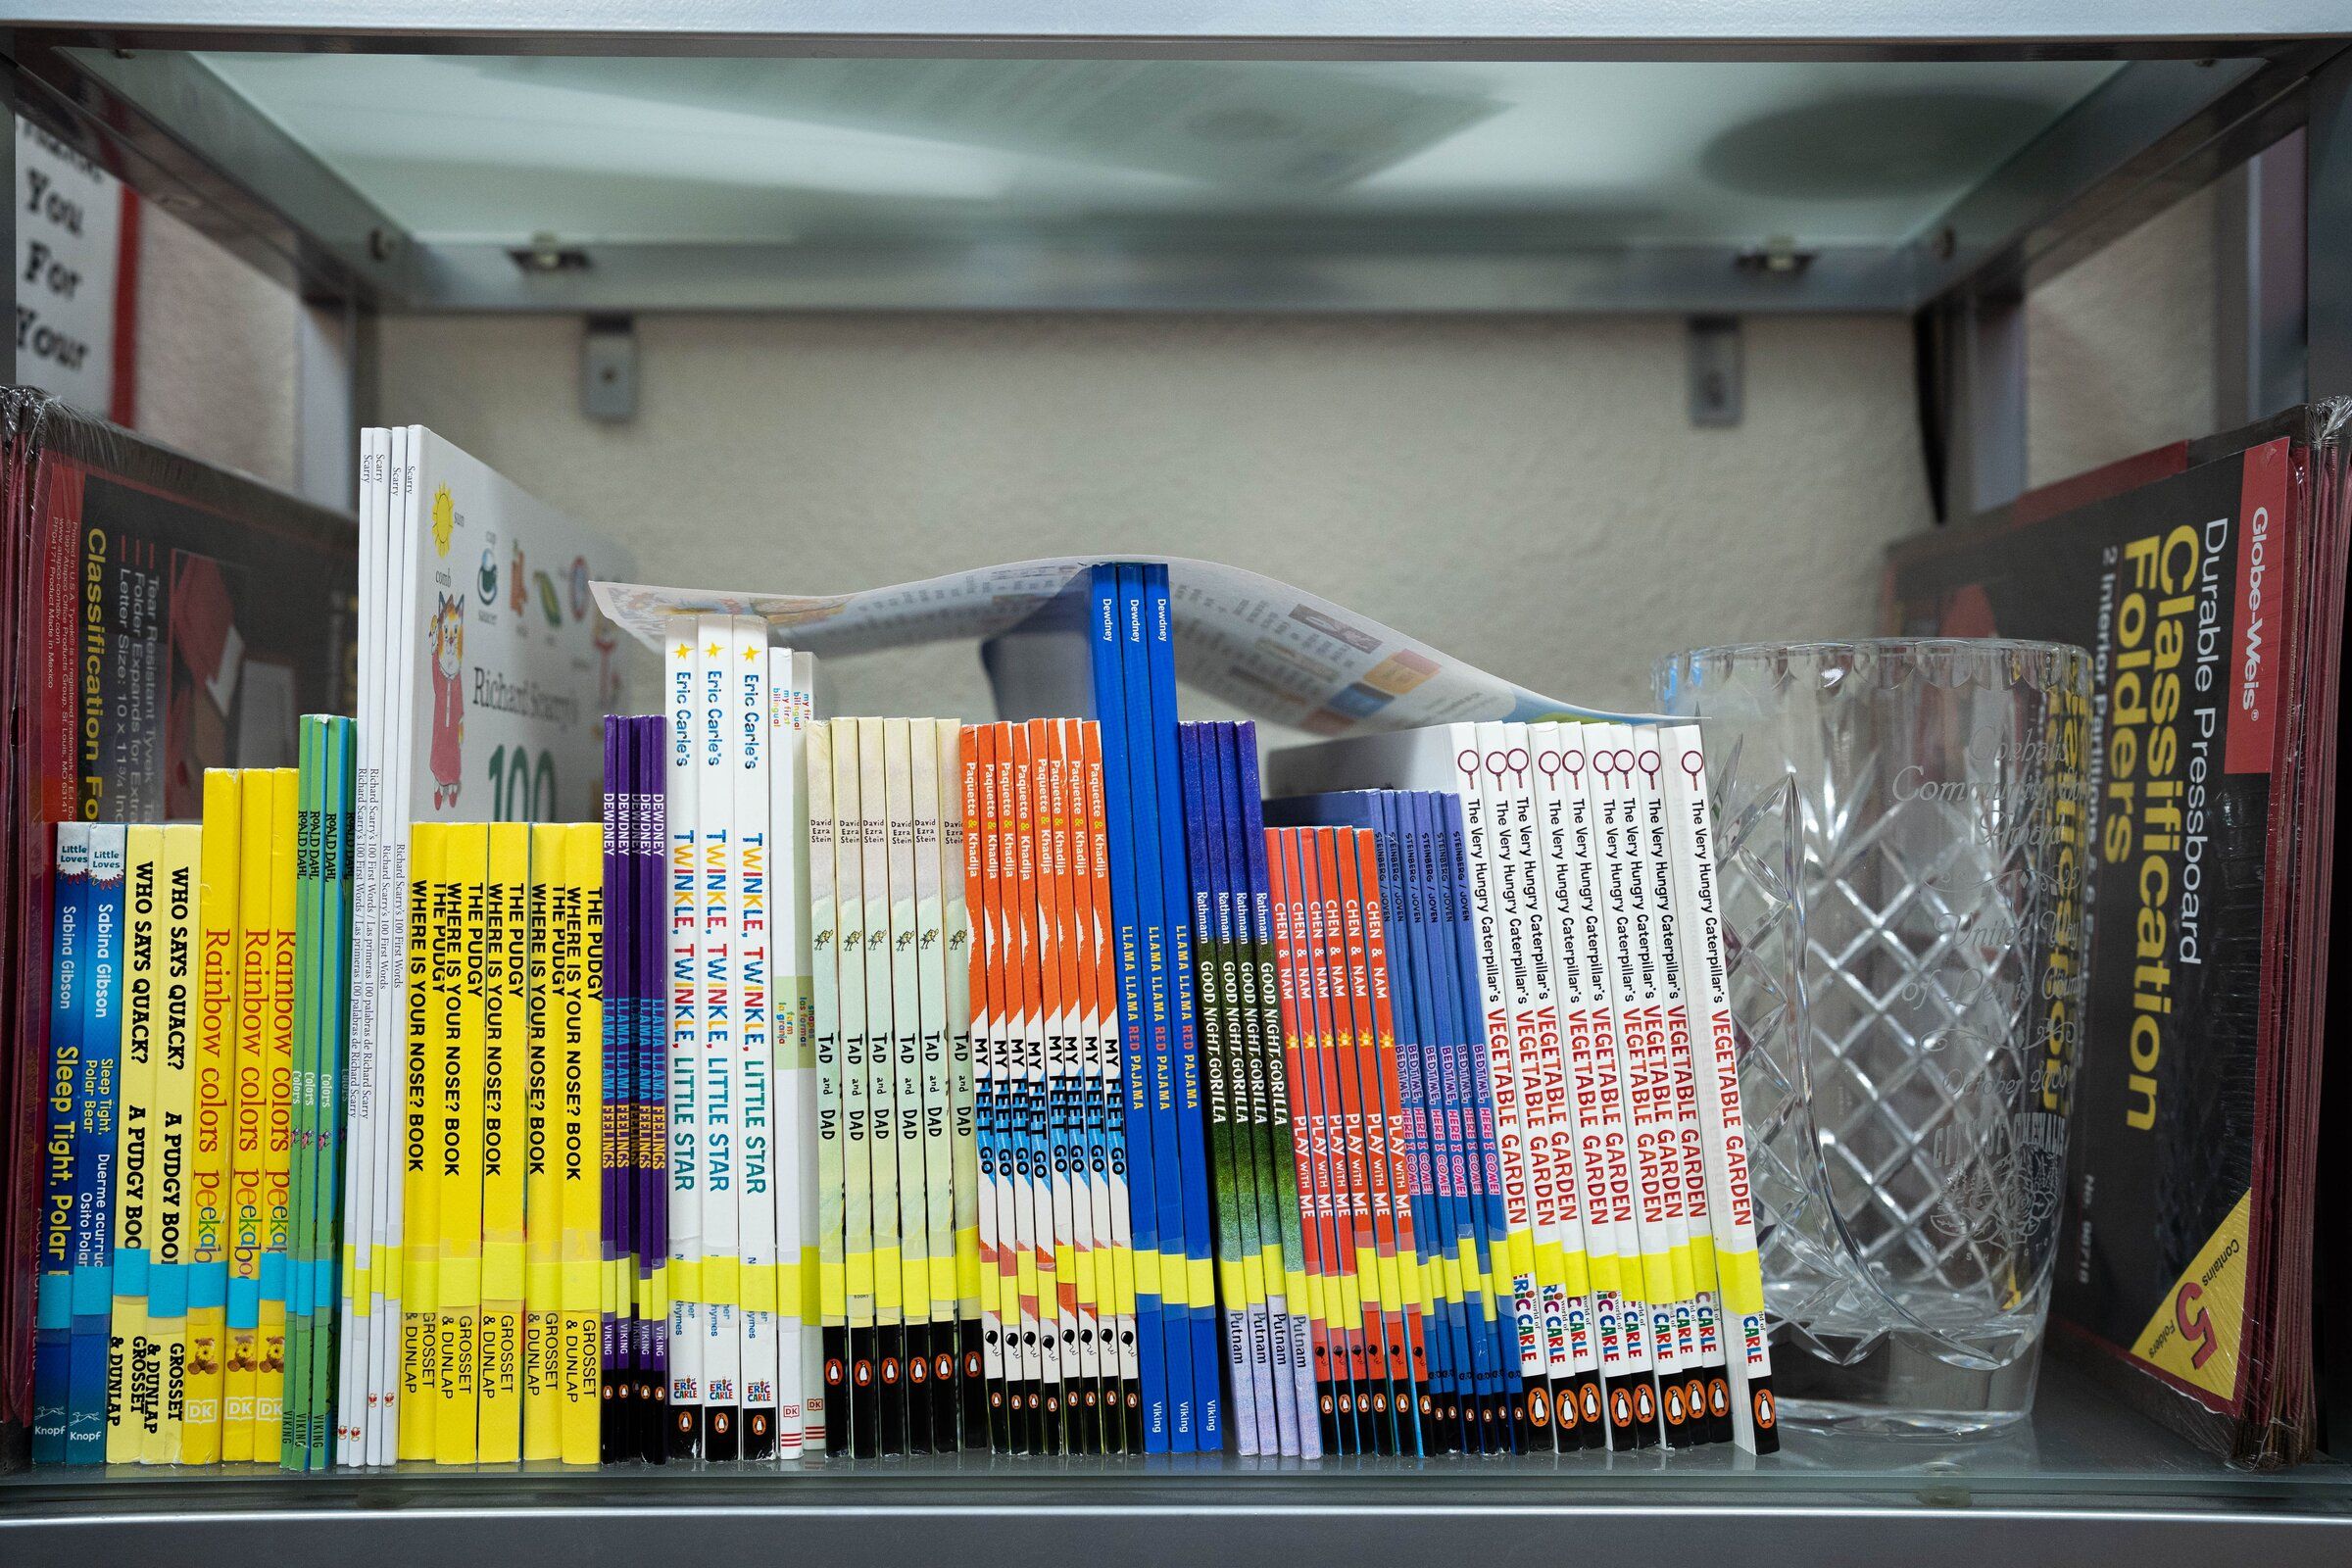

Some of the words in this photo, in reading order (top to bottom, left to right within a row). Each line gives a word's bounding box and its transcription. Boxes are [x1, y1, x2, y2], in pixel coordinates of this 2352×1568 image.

[374, 454, 384, 483] Scarry
[454, 512, 465, 527] sun
[2103, 545, 2119, 564] 2
[119, 568, 131, 629] Letter
[146, 576, 160, 620] Tear
[435, 568, 452, 588] comb
[131, 571, 145, 637] Folder
[1157, 598, 1167, 642] Dewdney
[2195, 517, 2228, 692] Durable
[86, 528, 106, 761] Classification
[2093, 573, 2118, 685] Interior
[117, 635, 129, 685] Size:
[145, 625, 158, 725] Resistant
[117, 694, 127, 717] 10
[130, 641, 143, 732] Expands
[744, 674, 759, 707] Eric
[771, 687, 780, 727] bilingual
[784, 690, 791, 705] my
[2106, 535, 2160, 863] Folders
[130, 738, 141, 766] for
[744, 710, 760, 769] Carle's
[369, 768, 379, 803] Richard
[1001, 762, 1011, 816] Paquette
[368, 805, 378, 840] Scarry's
[617, 794, 629, 857] DEWDNEY
[1004, 819, 1013, 829] &
[1468, 798, 1480, 824] The
[2127, 524, 2199, 1131] Classification
[94, 851, 120, 860] Little
[1004, 833, 1014, 878] Khadija
[1470, 827, 1484, 859] Very
[2180, 708, 2216, 964] Pressboard
[92, 860, 121, 870] Loves
[309, 848, 319, 880] DAHL
[368, 861, 376, 880] First
[741, 833, 762, 937] TWINKLE,
[1453, 831, 1465, 881] STEINBERG
[1460, 892, 1469, 921] JOVEN
[134, 861, 154, 914] WHO
[367, 883, 376, 912] Words
[467, 882, 484, 921] THE
[1474, 861, 1489, 913] Hungry
[98, 905, 113, 958] Sabina
[366, 921, 375, 937] Las
[446, 882, 462, 954] WHERE
[1236, 892, 1248, 945] Rathmann
[1325, 900, 1340, 937] CHEN
[134, 920, 152, 972] SAYS
[365, 938, 374, 978] primeras
[466, 927, 483, 999] PUDGY
[1149, 926, 1161, 972] LLAMA
[1330, 947, 1341, 956] &
[1481, 916, 1500, 1003] Caterpillar's
[95, 963, 112, 1018] Gibson
[446, 959, 461, 979] IS
[1332, 965, 1346, 997] NAM
[203, 929, 230, 1058] Rainbow
[445, 983, 462, 1041] YOUR
[742, 946, 764, 1052] TWINKLE,
[1152, 976, 1165, 1022] LLAMA
[130, 978, 151, 1064] QUACK?
[363, 1000, 373, 1039] palabras
[617, 999, 629, 1047] LLAMA
[776, 1014, 786, 1045] granja
[786, 1011, 795, 1035] farm
[1154, 1026, 1167, 1052] RED
[364, 1040, 372, 1050] de
[871, 1033, 888, 1064] TAD
[1028, 1042, 1042, 1070] MY
[1240, 961, 1255, 1004] GOOD
[1250, 1058, 1267, 1125] GORILLA
[51, 1047, 78, 1113] Sleep
[85, 1059, 97, 1097] Polar
[101, 1058, 113, 1095] Sleep
[305, 1072, 315, 1105] Colors
[363, 1052, 372, 1088] Richard
[445, 1046, 461, 1112] NOSE?
[617, 1053, 629, 1101] LLAMA
[876, 1077, 887, 1096] and
[1156, 1055, 1171, 1111] PAJAMA
[1488, 1007, 1517, 1127] VEGETABLE
[129, 1104, 146, 1121] A
[199, 1067, 227, 1152] colors
[362, 1089, 371, 1120] Scarry
[744, 1061, 765, 1129] LITTLE
[1029, 1082, 1048, 1140] FEET
[83, 1101, 96, 1134] Bear
[99, 1099, 113, 1136] Tight,
[616, 1105, 629, 1169] FEELINGS
[874, 1108, 889, 1140] DAD
[1346, 1113, 1362, 1155] PLAY
[1480, 1108, 1494, 1140] HERE
[48, 1121, 75, 1186] Tight,
[126, 1128, 145, 1200] PUDGY
[444, 1118, 460, 1177] BOOK
[745, 1136, 766, 1195] STAR
[1033, 1150, 1048, 1179] GO
[97, 1153, 110, 1208] Duerme
[1486, 1153, 1501, 1196] COME!
[1501, 1134, 1528, 1225] GARDEN
[80, 1193, 92, 1221] Osito
[1351, 1193, 1368, 1217] ME
[48, 1196, 73, 1260] Polar
[78, 1224, 91, 1267] Polar
[2202, 1238, 2240, 1287] Contains
[111, 1336, 124, 1348] &
[482, 1316, 496, 1326] &
[1274, 1313, 1287, 1365] Putnam
[1545, 1316, 1565, 1363] CARLE
[2148, 1319, 2176, 1358] Folders
[2176, 1281, 2219, 1371] 5
[130, 1336, 147, 1414] GROSSET
[483, 1331, 496, 1398] DUNLAP
[500, 1314, 514, 1394] GROSSET
[108, 1352, 123, 1426] DUNLAP
[673, 1382, 697, 1391] ERIC
[673, 1390, 697, 1399] CARLE
[34, 1425, 66, 1438] Knopf
[189, 1404, 213, 1418] DK
[313, 1414, 323, 1448] VIKING
[1179, 1401, 1189, 1433] Viking
